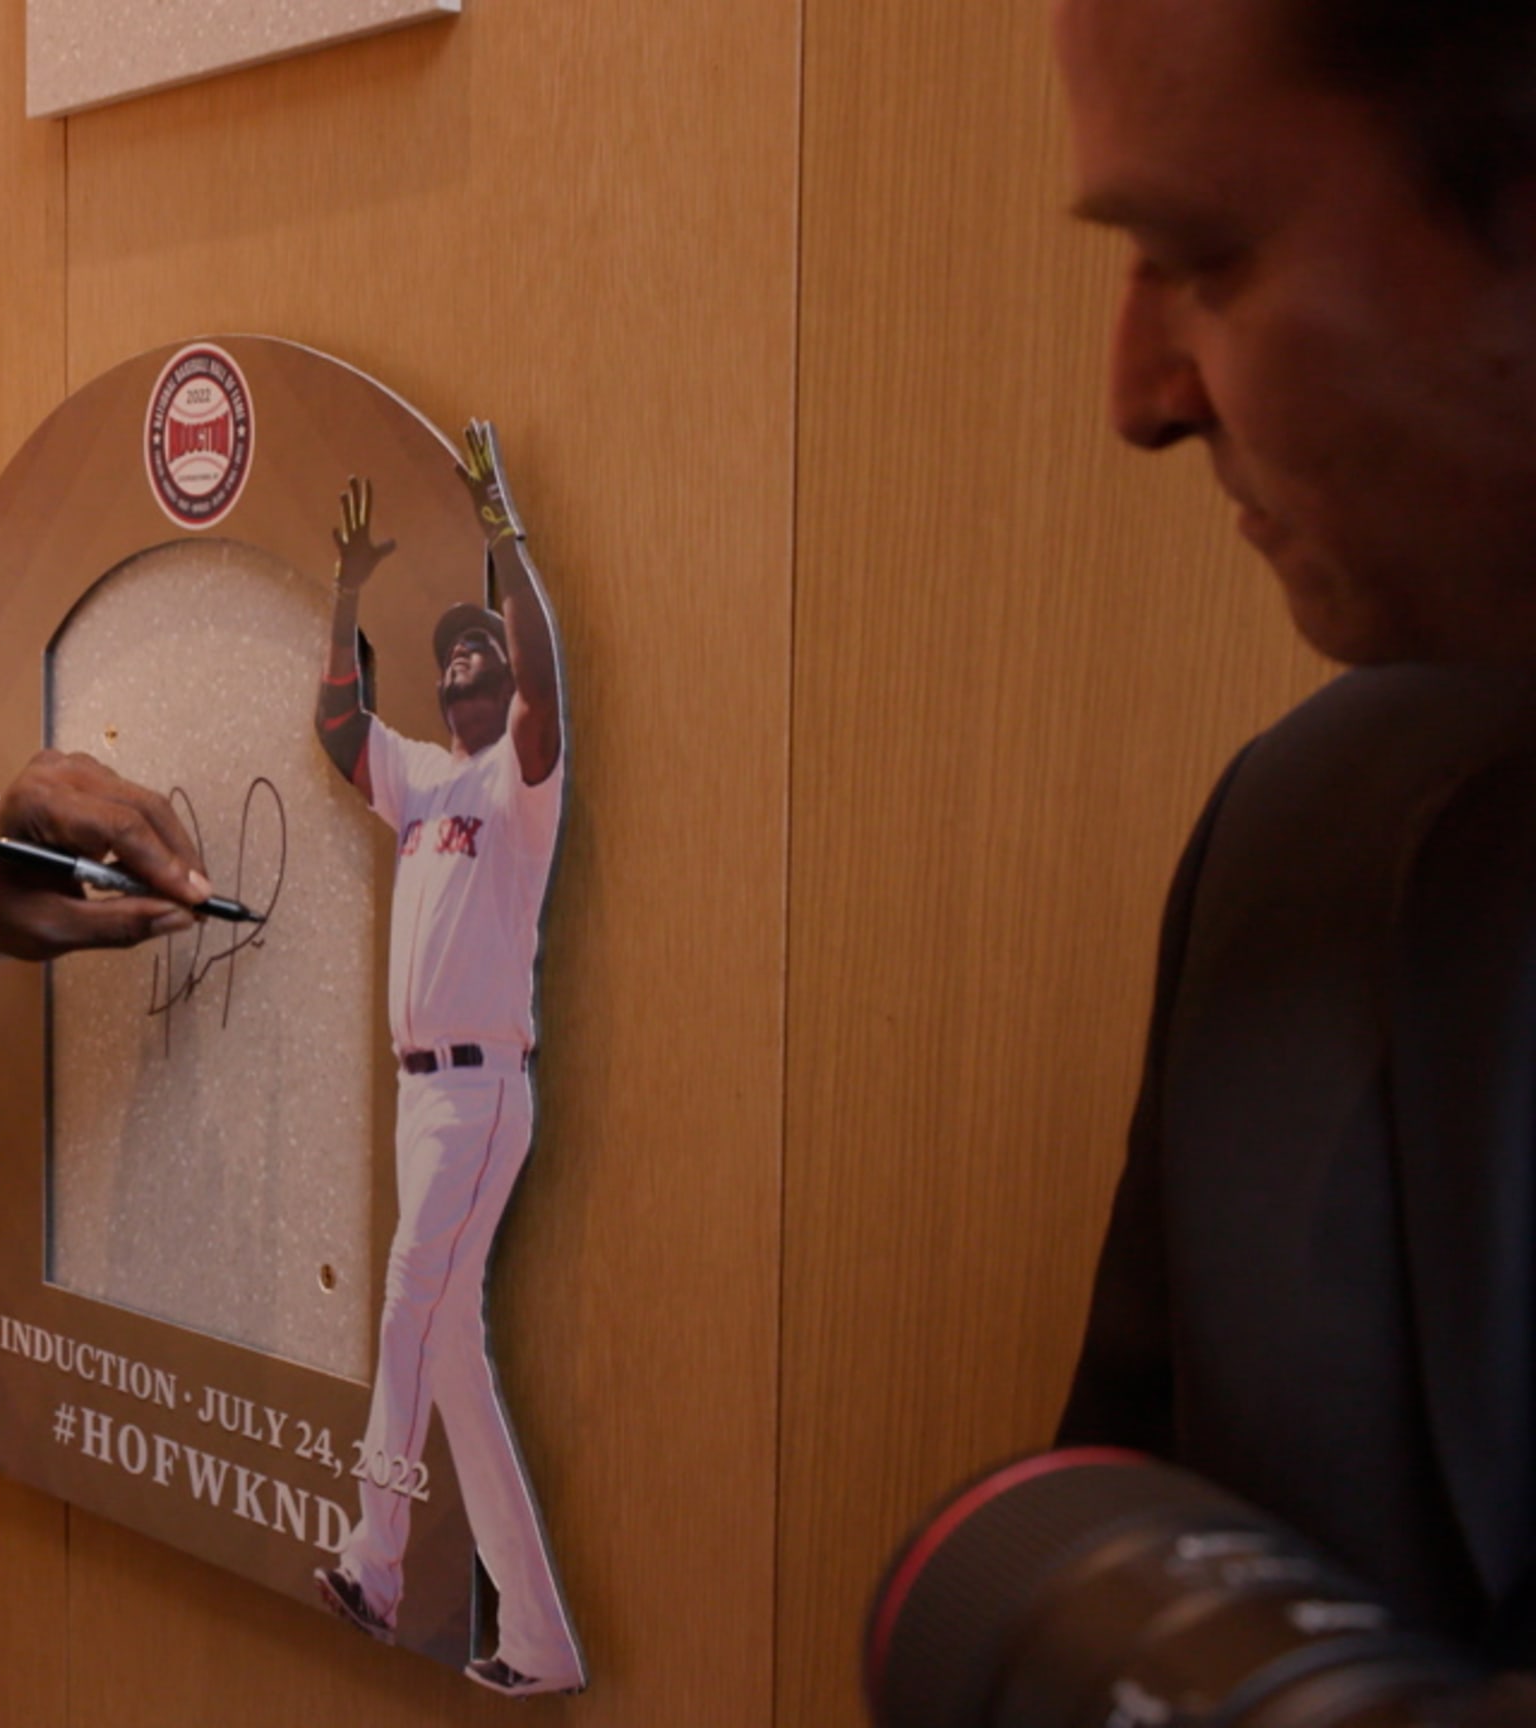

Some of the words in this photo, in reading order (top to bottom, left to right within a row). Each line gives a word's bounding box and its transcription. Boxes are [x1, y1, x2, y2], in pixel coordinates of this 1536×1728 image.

[0, 1315, 177, 1410] INDUCTION
[197, 1385, 289, 1449] JULY
[295, 1420, 343, 1479] 24,
[350, 1440, 431, 1502] 2022
[52, 1402, 352, 1555] #HOFWKND
